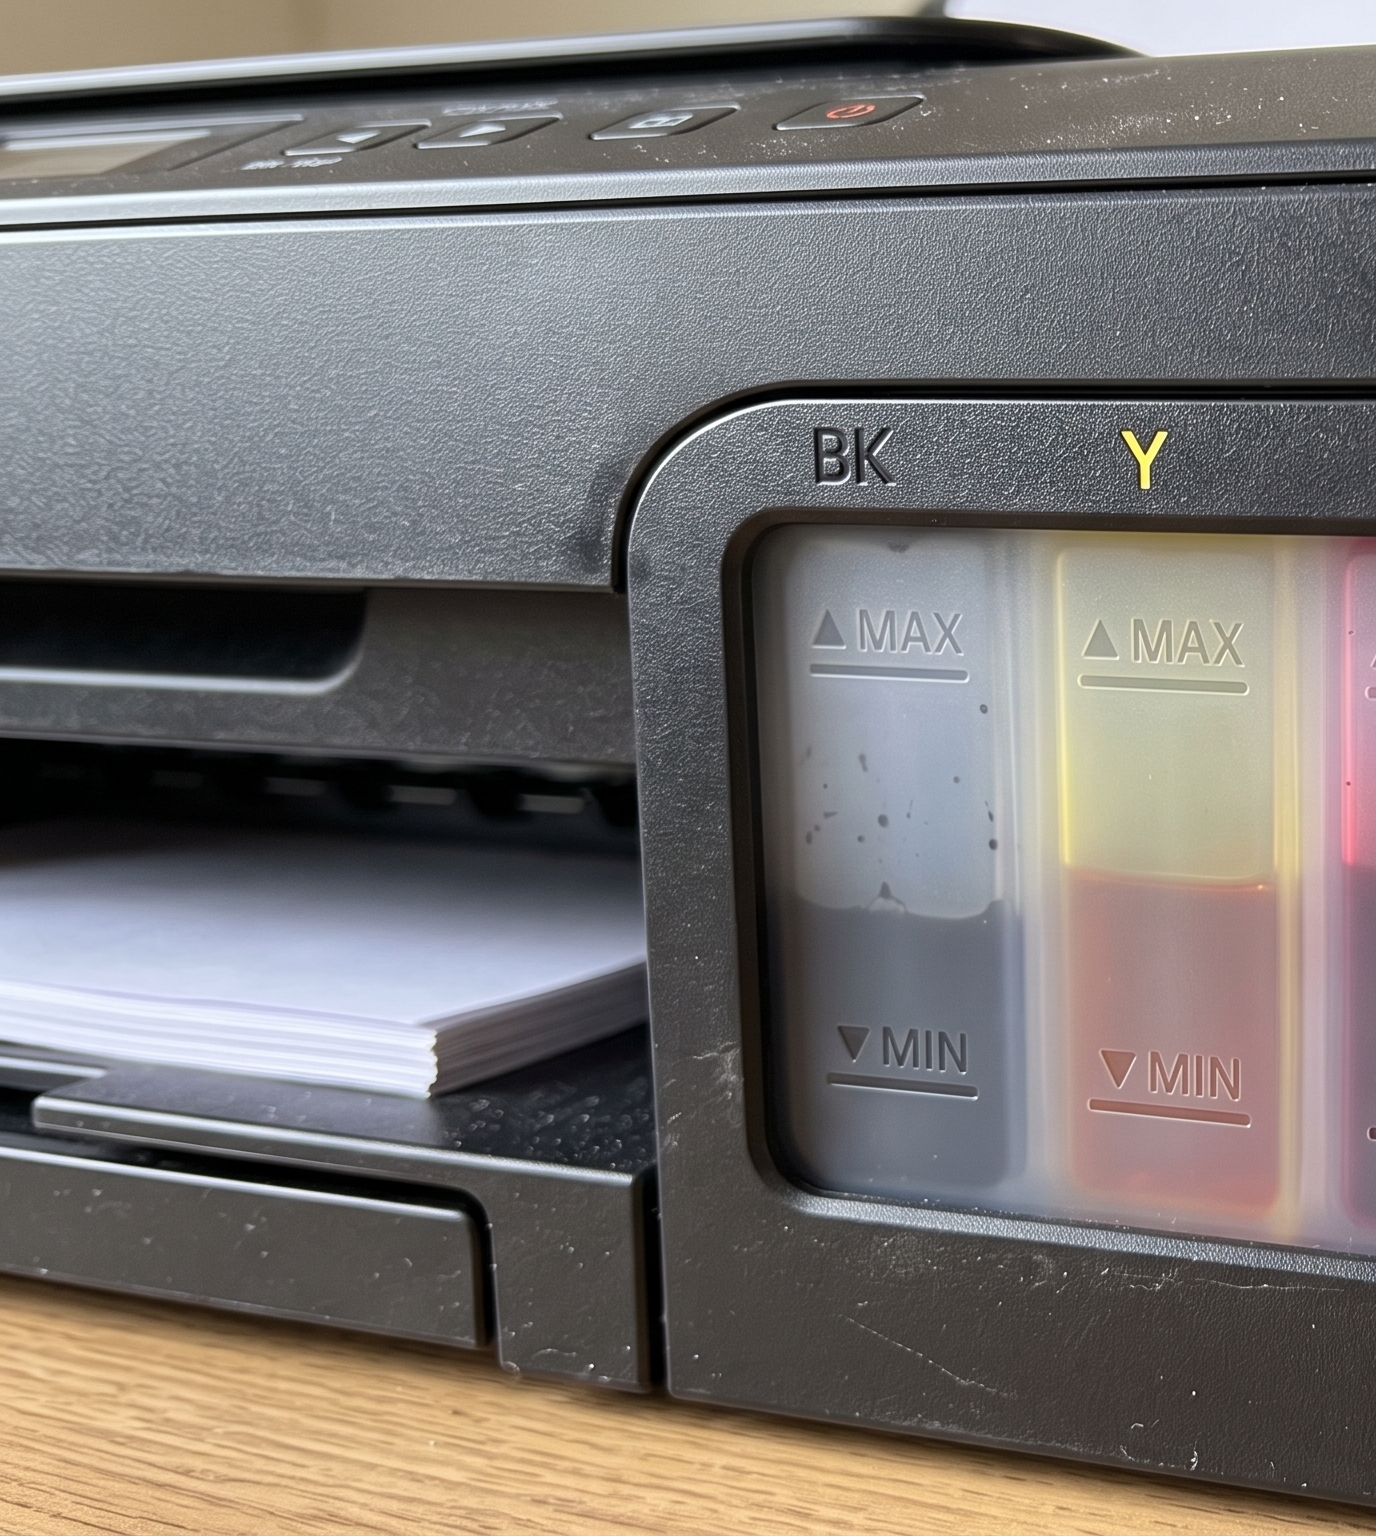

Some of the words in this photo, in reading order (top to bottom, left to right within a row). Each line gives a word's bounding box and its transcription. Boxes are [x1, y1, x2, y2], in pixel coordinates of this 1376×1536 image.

[813, 427, 897, 486] BK
[1121, 430, 1168, 490] Y
[856, 608, 964, 656] MAX
[1131, 618, 1245, 668] MAX
[882, 1025, 967, 1075] MIN
[1148, 1050, 1242, 1102] MIN
